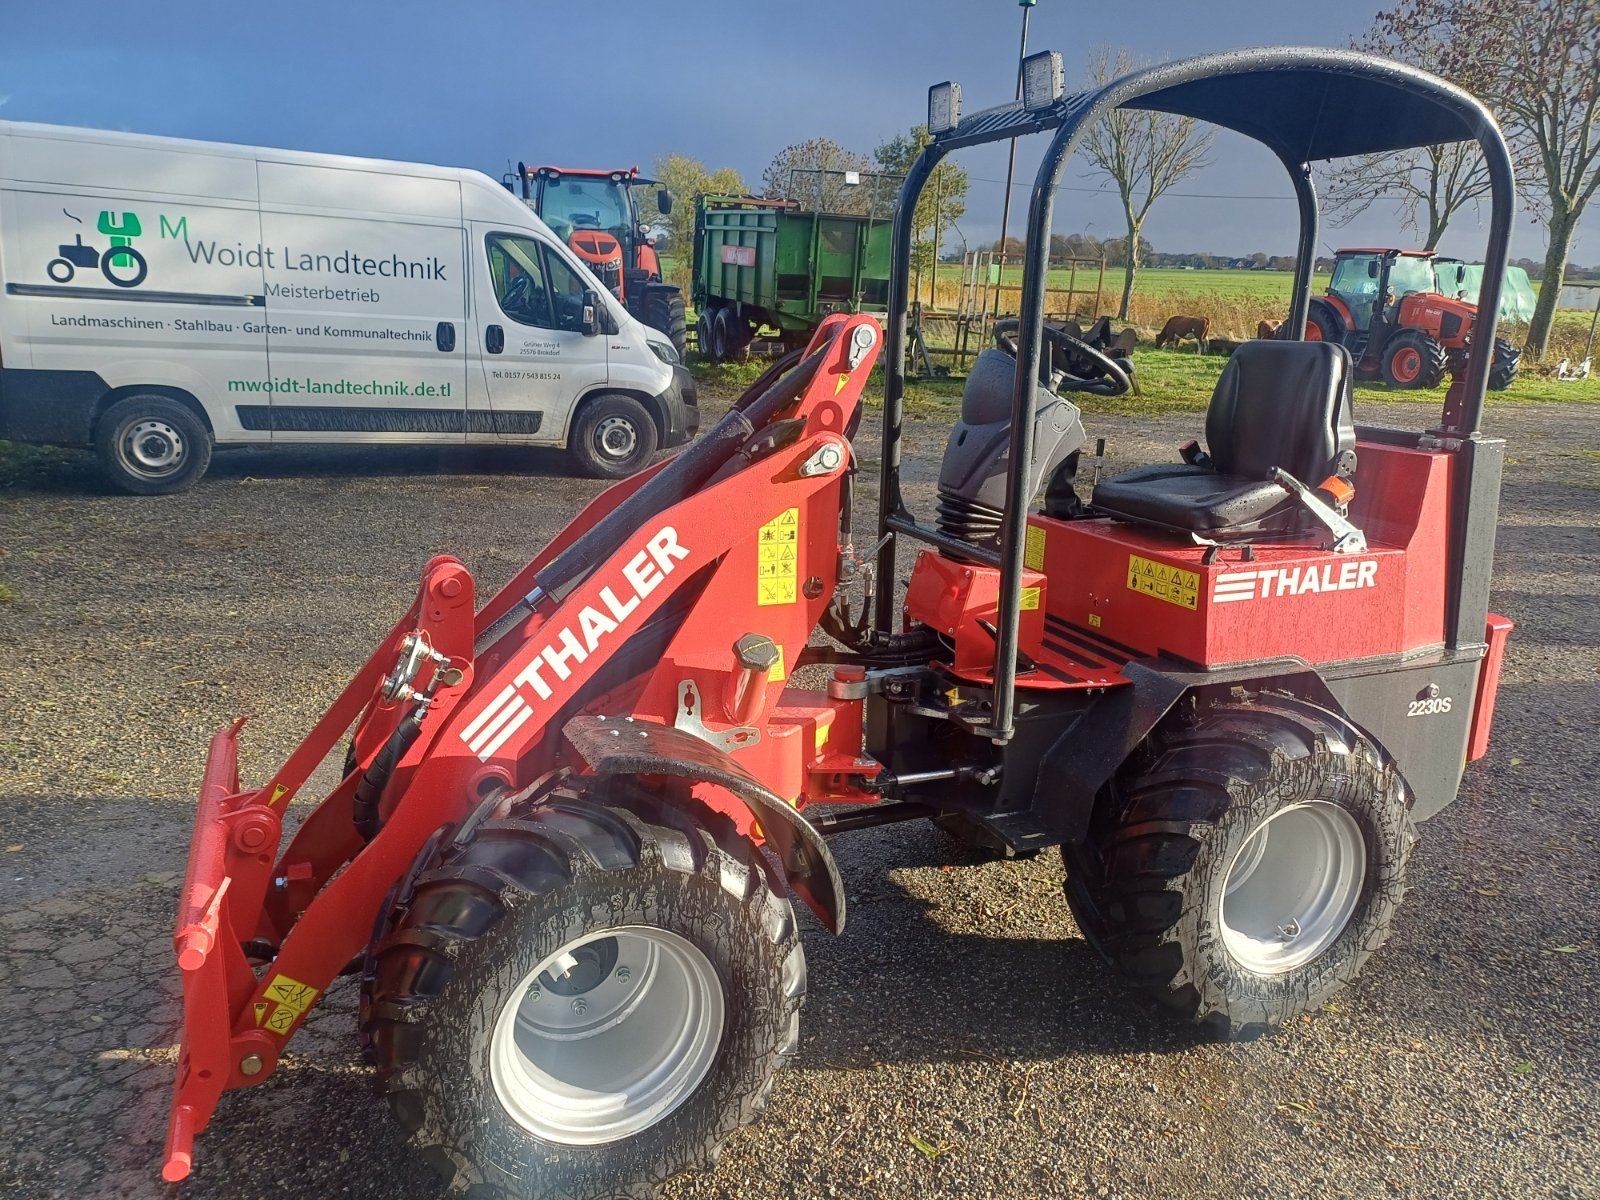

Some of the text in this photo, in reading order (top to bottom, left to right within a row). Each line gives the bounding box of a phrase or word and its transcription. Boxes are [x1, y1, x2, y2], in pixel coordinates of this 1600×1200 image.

[160, 214, 187, 240] M
[184, 240, 447, 281] Woidt Landtechnik
[264, 282, 380, 304] Meisterbetrieb
[51, 314, 433, 342] Landmaschinen Stahlbau Garten- und Kommunaltechnik
[228, 376, 451, 397] mwoidt-landtechnik.de.tl
[492, 371, 503, 379] Tel.
[1255, 560, 1378, 599] THALER
[513, 525, 690, 701] THALER
[1407, 697, 1452, 717] 2230S
